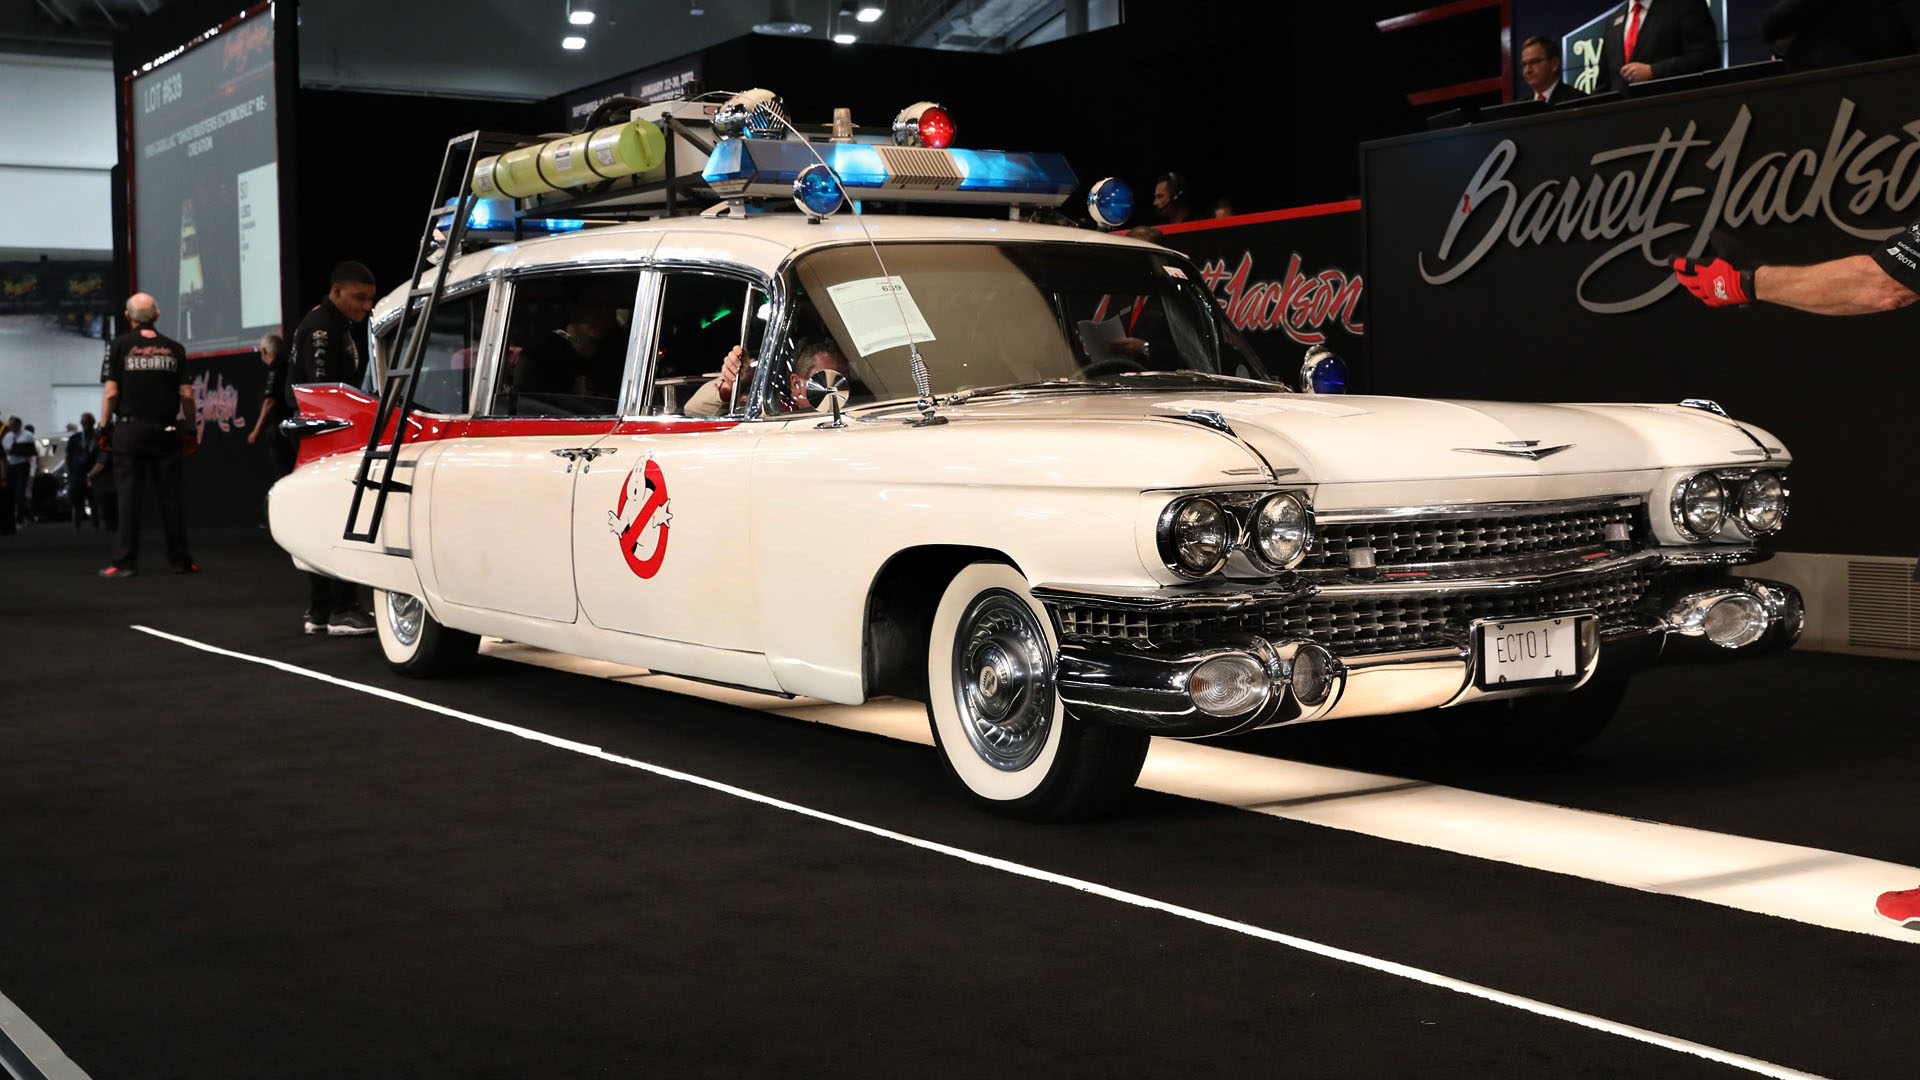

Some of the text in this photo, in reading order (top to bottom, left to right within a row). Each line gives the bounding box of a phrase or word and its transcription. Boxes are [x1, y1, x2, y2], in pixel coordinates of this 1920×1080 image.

[144, 82, 161, 114] LOT
[1418, 97, 1920, 314] Barrett-Jackso
[127, 356, 177, 370] SECURITY
[1496, 628, 1552, 664] ECTO 1
